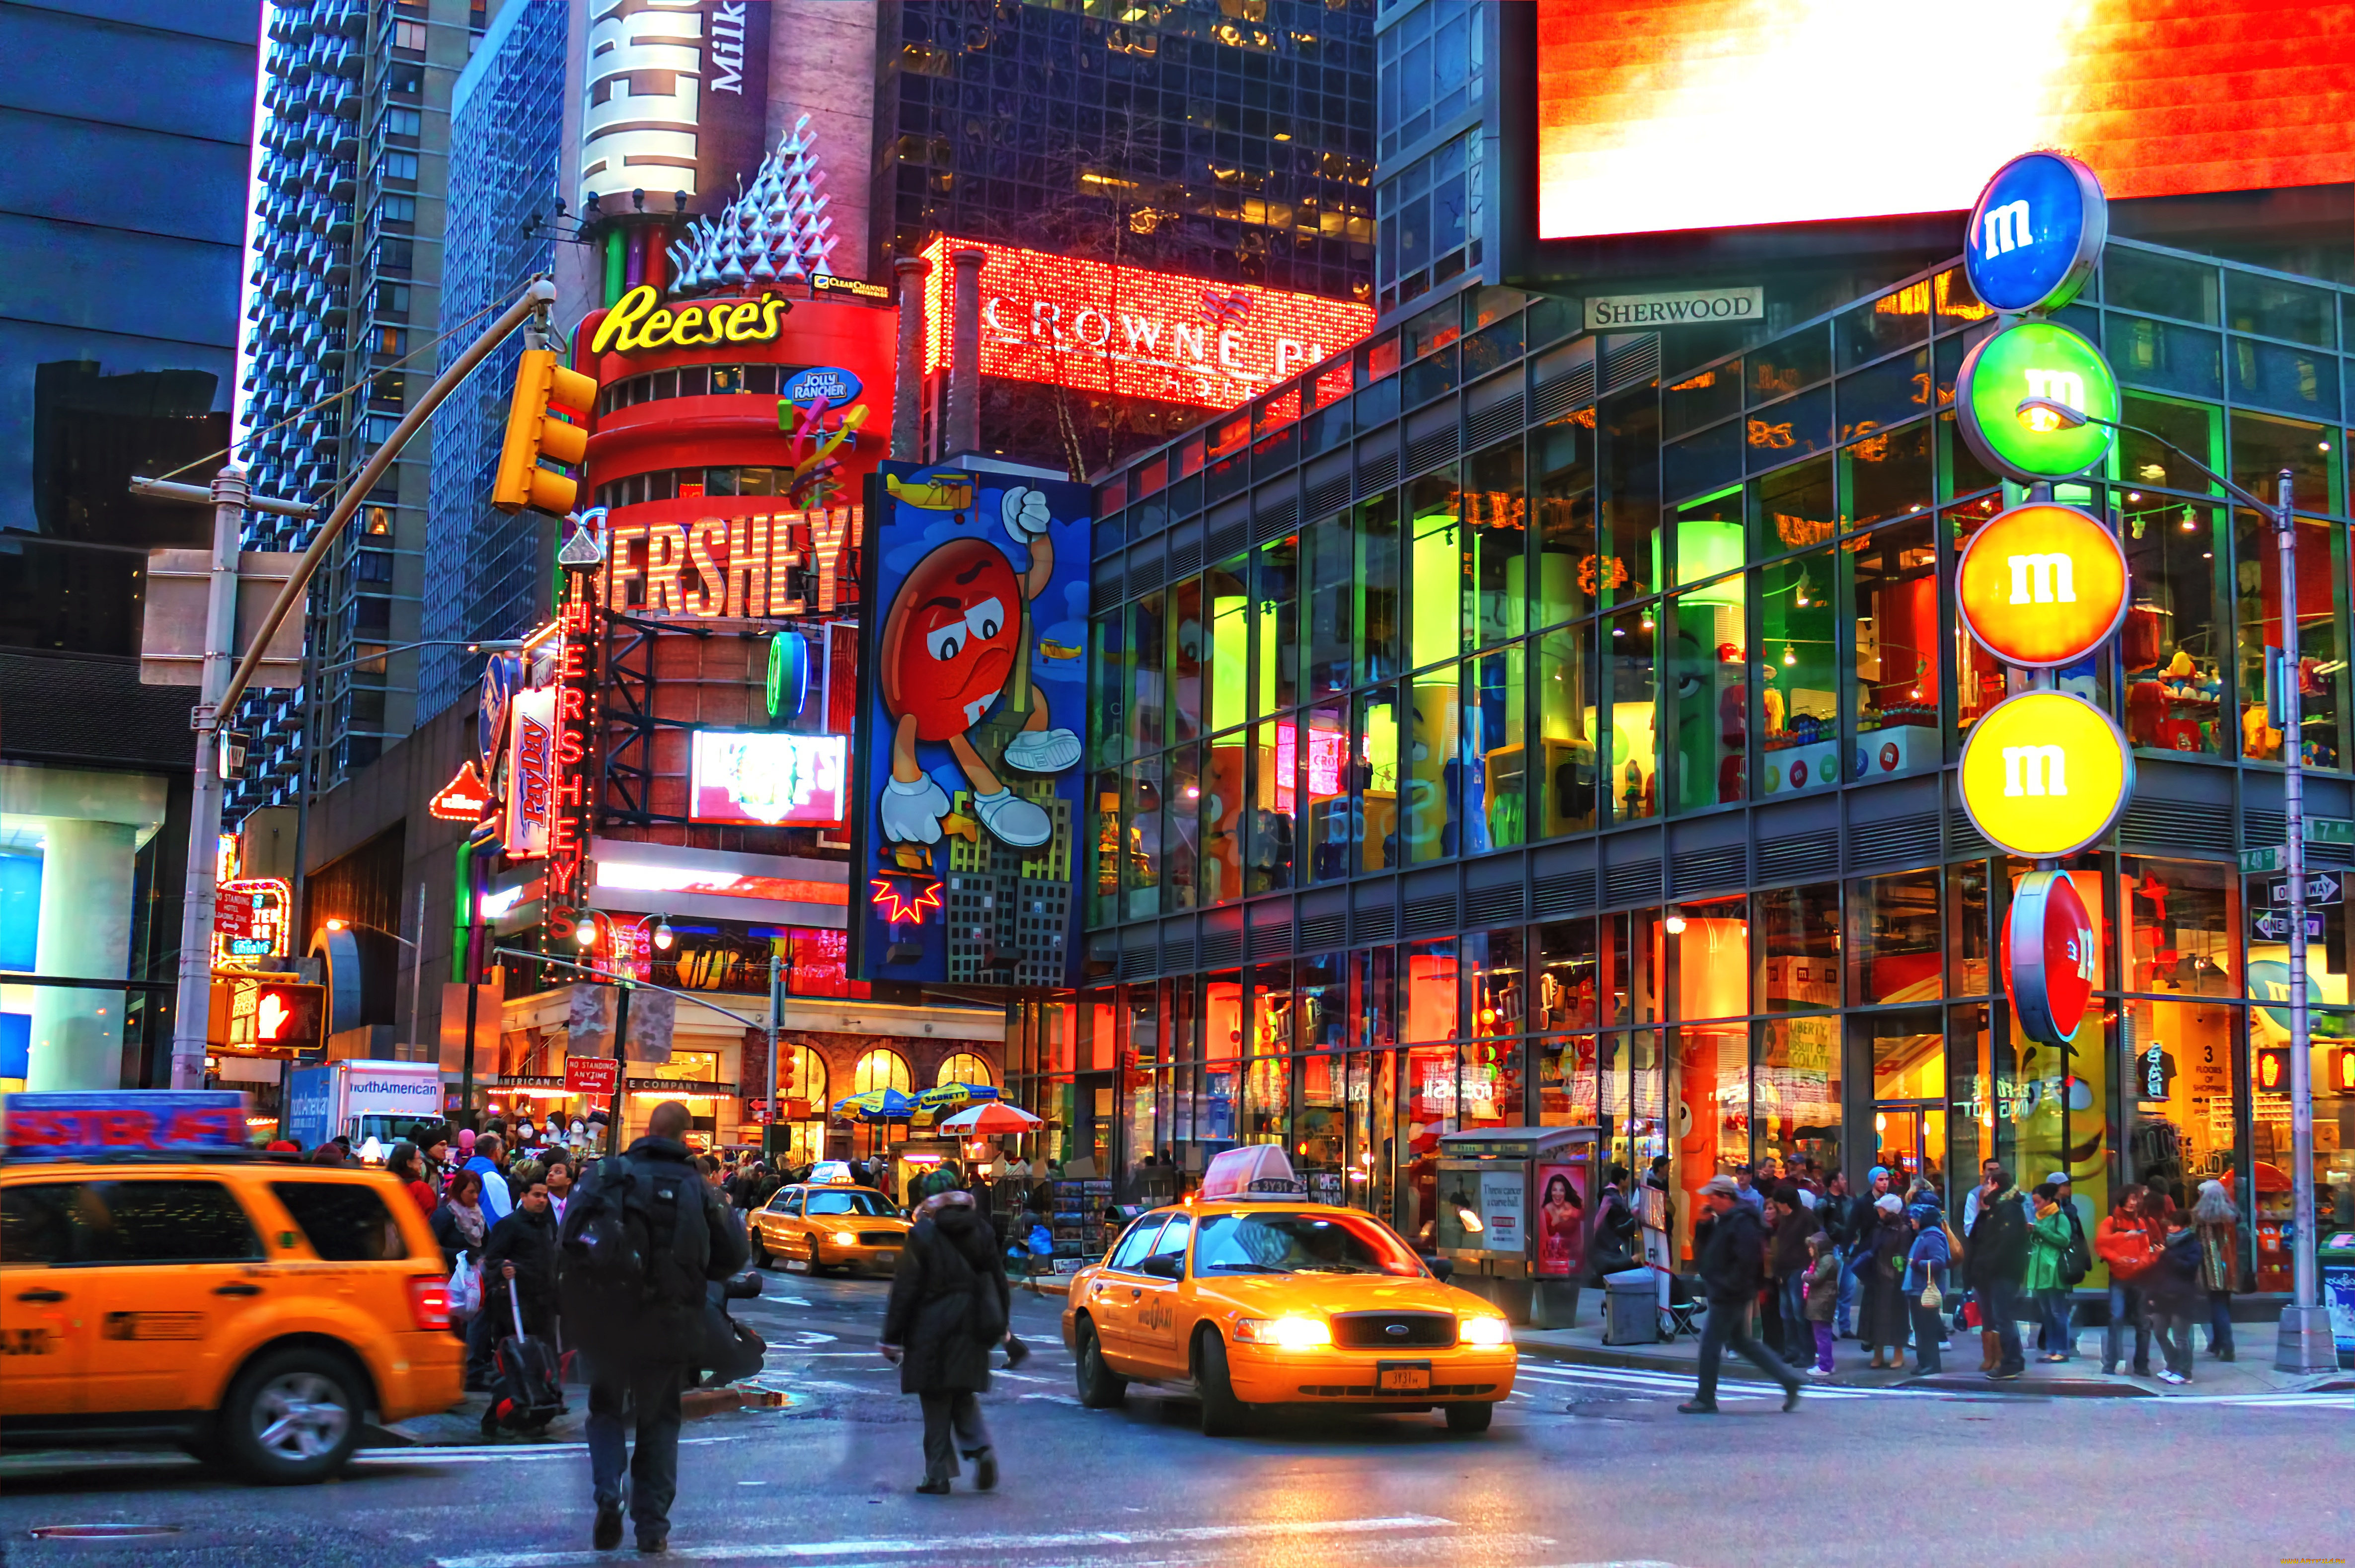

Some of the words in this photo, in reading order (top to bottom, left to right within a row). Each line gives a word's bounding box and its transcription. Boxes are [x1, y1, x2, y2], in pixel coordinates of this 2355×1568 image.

[711, 1, 745, 95] Milk
[580, 0, 702, 208] HER
[1984, 200, 2033, 260] m
[1596, 297, 1752, 324] SHERWOOD
[591, 285, 786, 353] Reese's
[987, 297, 1243, 369] CROWNE
[804, 373, 836, 387] JOLLY
[794, 384, 845, 398] RANCHER
[2008, 553, 2077, 604] m
[519, 713, 551, 827] PayDay
[2002, 745, 2067, 796] m
[2320, 822, 2330, 840] 7
[2240, 853, 2248, 870] W
[2251, 851, 2263, 869] 48
[2308, 881, 2331, 895] WAY
[2262, 919, 2282, 932] ONE
[234, 1002, 255, 1015] PARK
[1784, 1040, 1814, 1053] URSUIT
[1816, 1043, 1827, 1055] OF
[2203, 1045, 2213, 1063] 3
[582, 1061, 614, 1071] STANDING
[2195, 1066, 2223, 1074] FLOORS
[498, 1076, 550, 1087] AMERICAN
[643, 1081, 698, 1091] COMPANY
[574, 1071, 608, 1080] ANYTIME
[2193, 1084, 2227, 1093] SHOPPING
[1263, 1180, 1288, 1192] 3Y31
